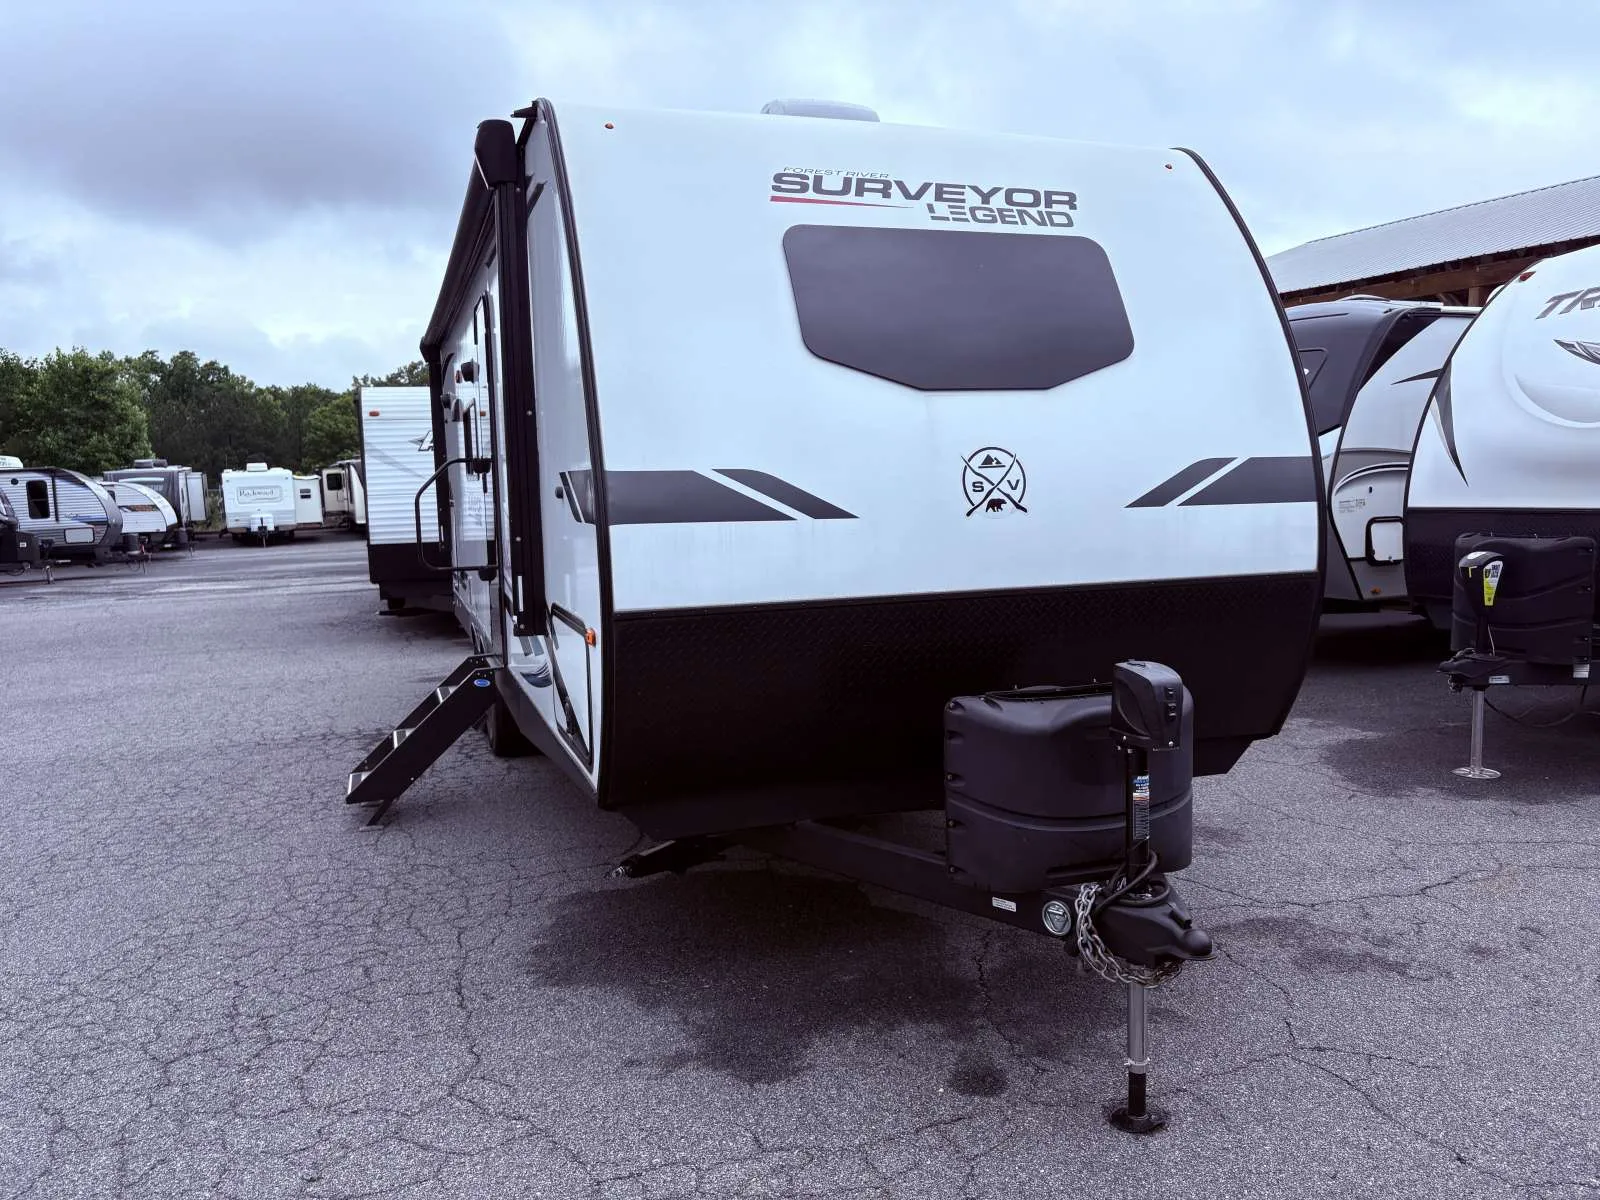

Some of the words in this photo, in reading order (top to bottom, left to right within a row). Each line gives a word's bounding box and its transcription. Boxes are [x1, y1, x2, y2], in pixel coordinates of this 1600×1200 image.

[783, 167, 843, 176] FOREST
[845, 170, 889, 179] RIVER
[771, 172, 1078, 210] SURVEYOR
[926, 203, 1075, 228] LEGEND
[972, 481, 985, 492] S
[1007, 479, 1020, 490] V
